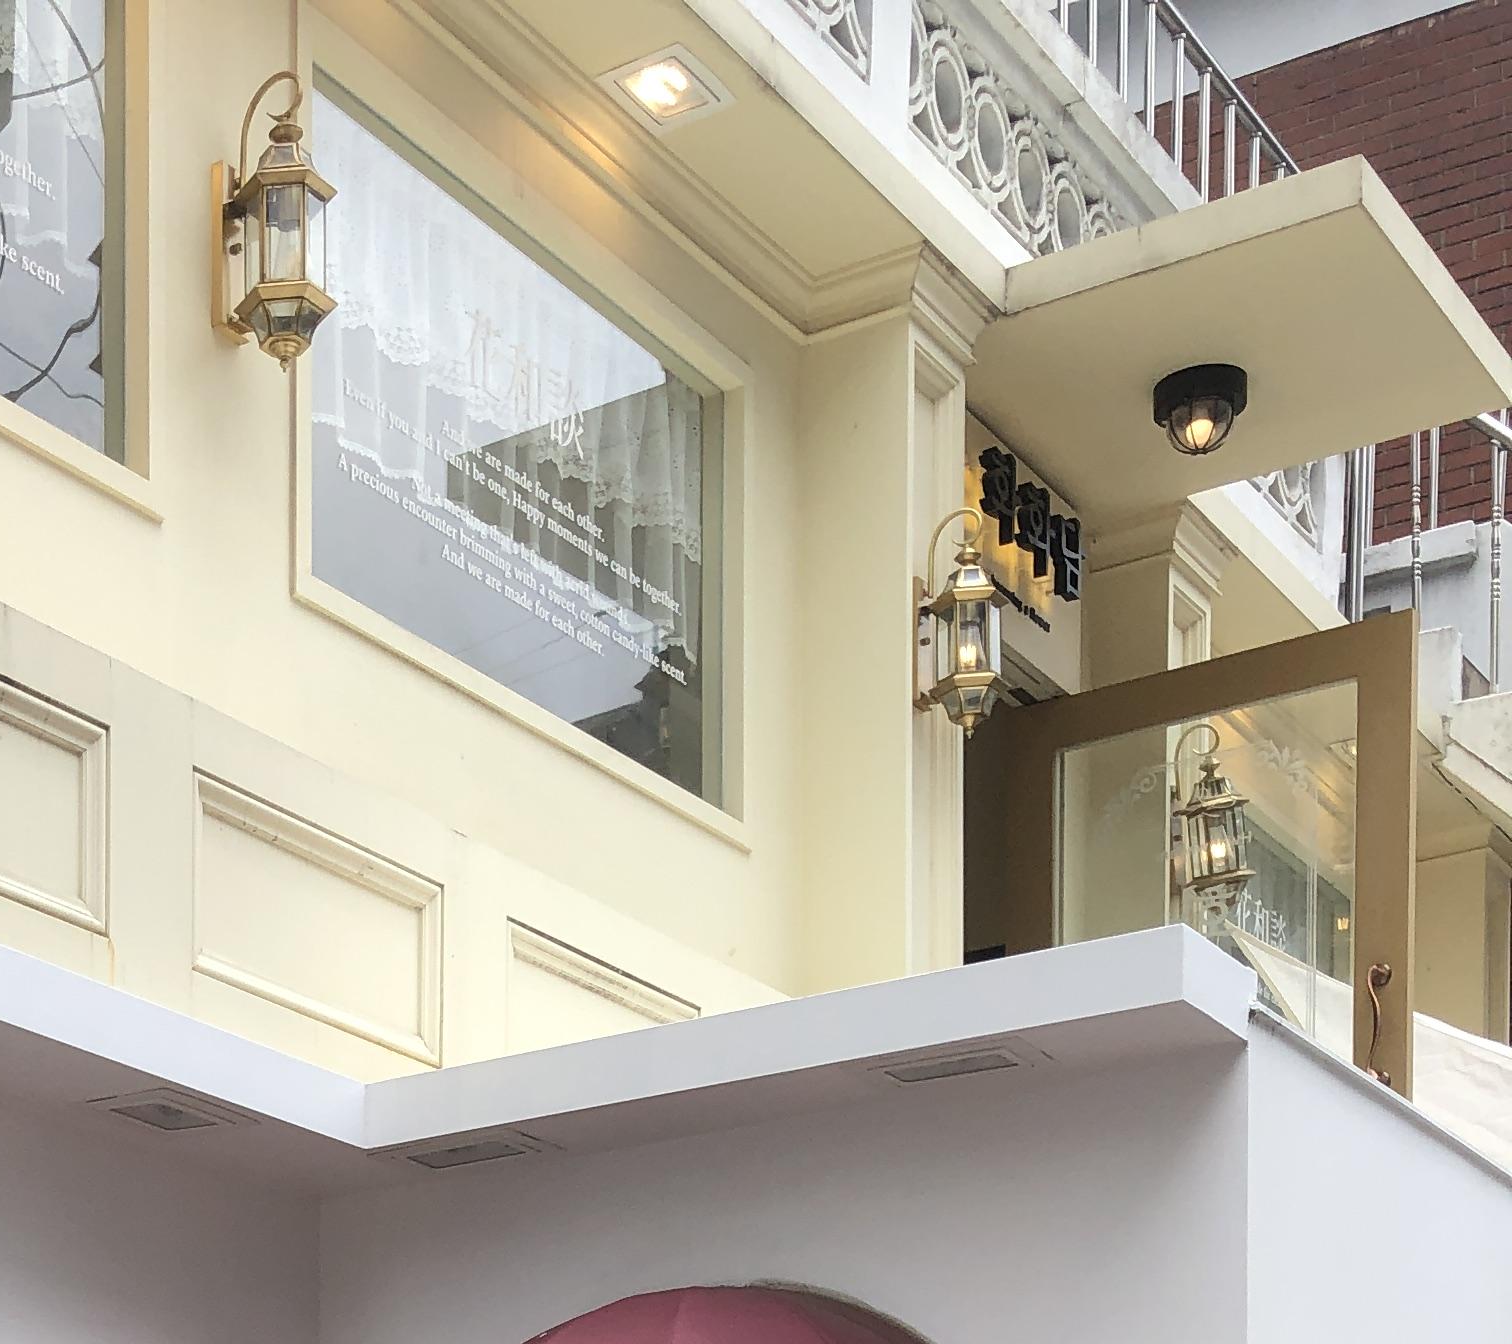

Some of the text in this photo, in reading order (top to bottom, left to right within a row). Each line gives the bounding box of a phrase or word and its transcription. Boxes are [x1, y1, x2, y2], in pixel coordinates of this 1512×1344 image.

[22, 255, 65, 295] scent.
[388, 410, 409, 436] you
[409, 428, 433, 451] ad
[444, 450, 471, 476] can't
[473, 463, 486, 485] be
[488, 478, 510, 505] one,
[513, 490, 546, 529] Happy
[547, 517, 593, 556] moments
[596, 550, 609, 567] we
[610, 559, 627, 580] can
[630, 567, 641, 589] be
[642, 579, 682, 617] together.
[441, 420, 465, 445] And
[485, 451, 502, 472] are
[504, 463, 533, 492] made
[535, 481, 551, 505] for
[552, 496, 575, 522] each
[576, 510, 606, 543] other.
[338, 453, 348, 472] A
[351, 462, 399, 504] precious
[402, 495, 458, 540] encounter
[460, 528, 512, 578] brimming
[513, 566, 537, 590] with
[548, 588, 578, 620] sweet,
[580, 609, 610, 637] cotton
[612, 629, 660, 668] candy-like
[661, 658, 688, 686] scent.
[441, 544, 605, 657] And we are made for each other.
